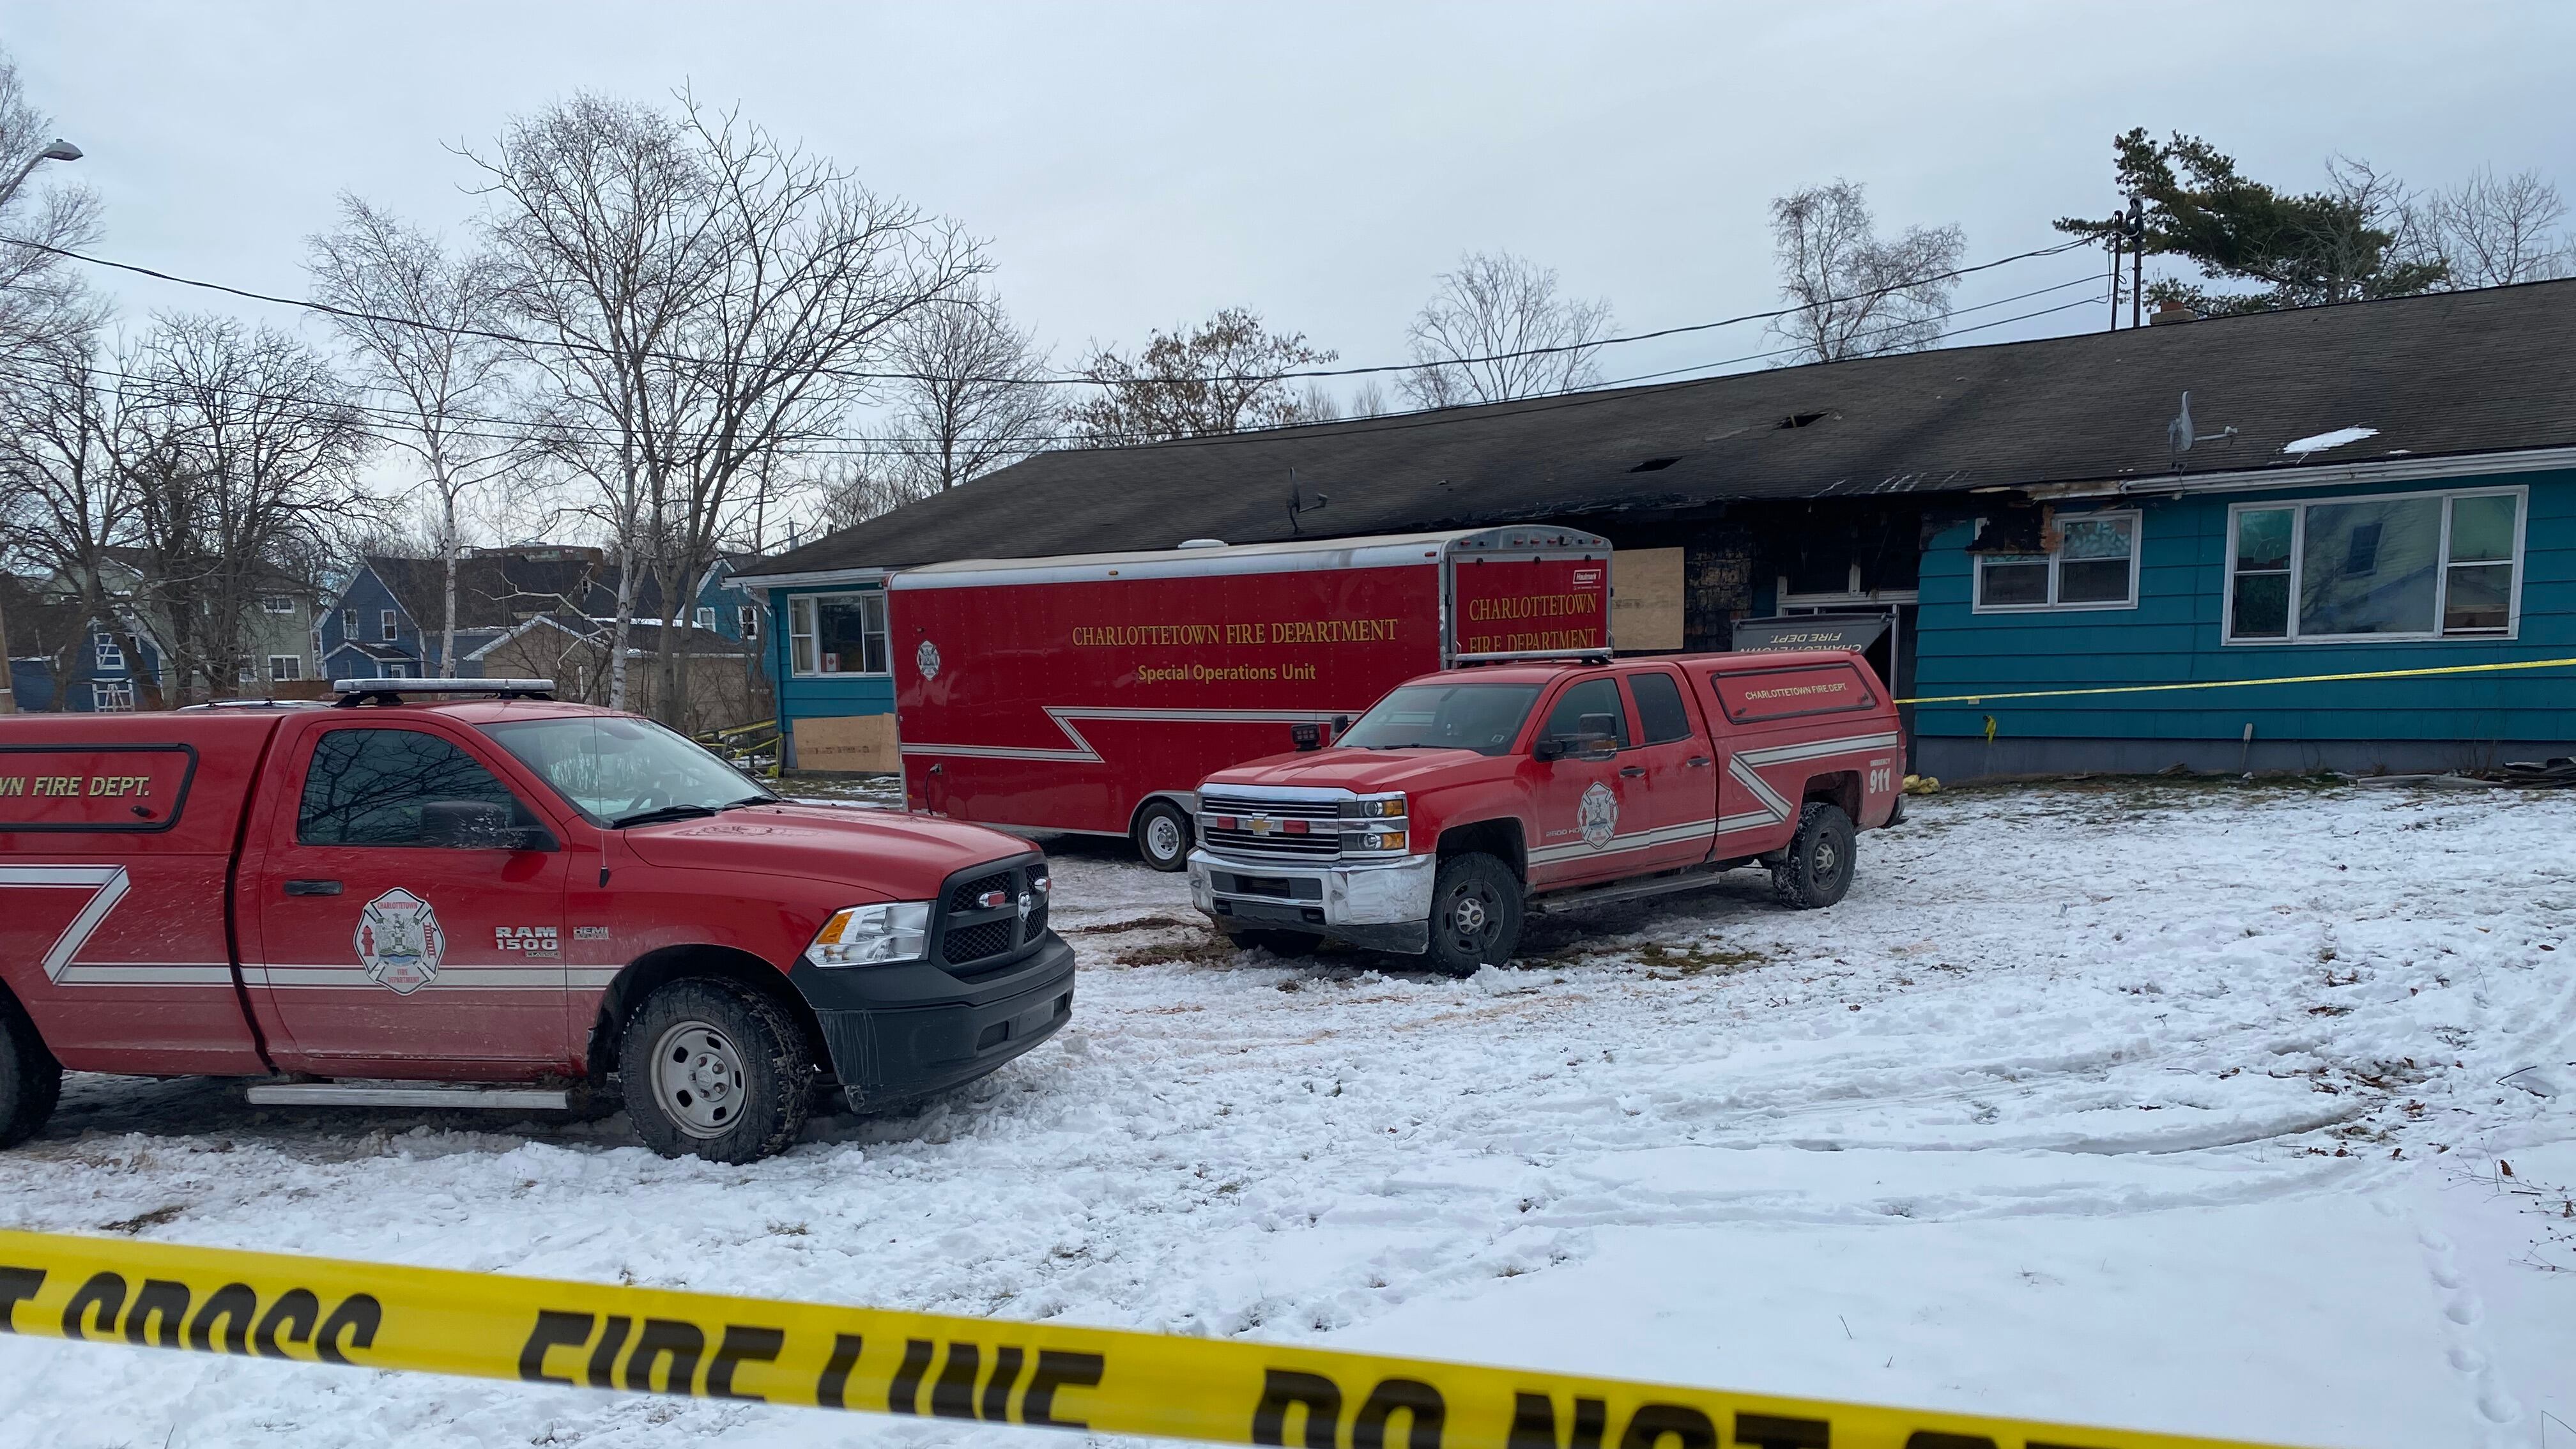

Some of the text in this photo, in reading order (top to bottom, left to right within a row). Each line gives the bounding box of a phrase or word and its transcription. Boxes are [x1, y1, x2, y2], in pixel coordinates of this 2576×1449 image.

[1469, 593, 1597, 621] CHARLOTTETOWN
[1072, 618, 1398, 646] CHARLOTTETOWN FIRE DEPARTMENT
[1469, 628, 1597, 652] FIRE DEPARTMENT
[1770, 632, 1842, 643] FIRE DEPT.
[1138, 663, 1316, 684] Special Operations Unit
[1745, 687, 1811, 700] CHARLOTTETOWN
[1812, 684, 1828, 694] FIRE
[32, 776, 82, 796] FIRE
[88, 776, 150, 796] DEPT.
[1870, 768, 1890, 794] 911
[496, 926, 557, 938] RAM
[496, 939, 558, 951] 1500
